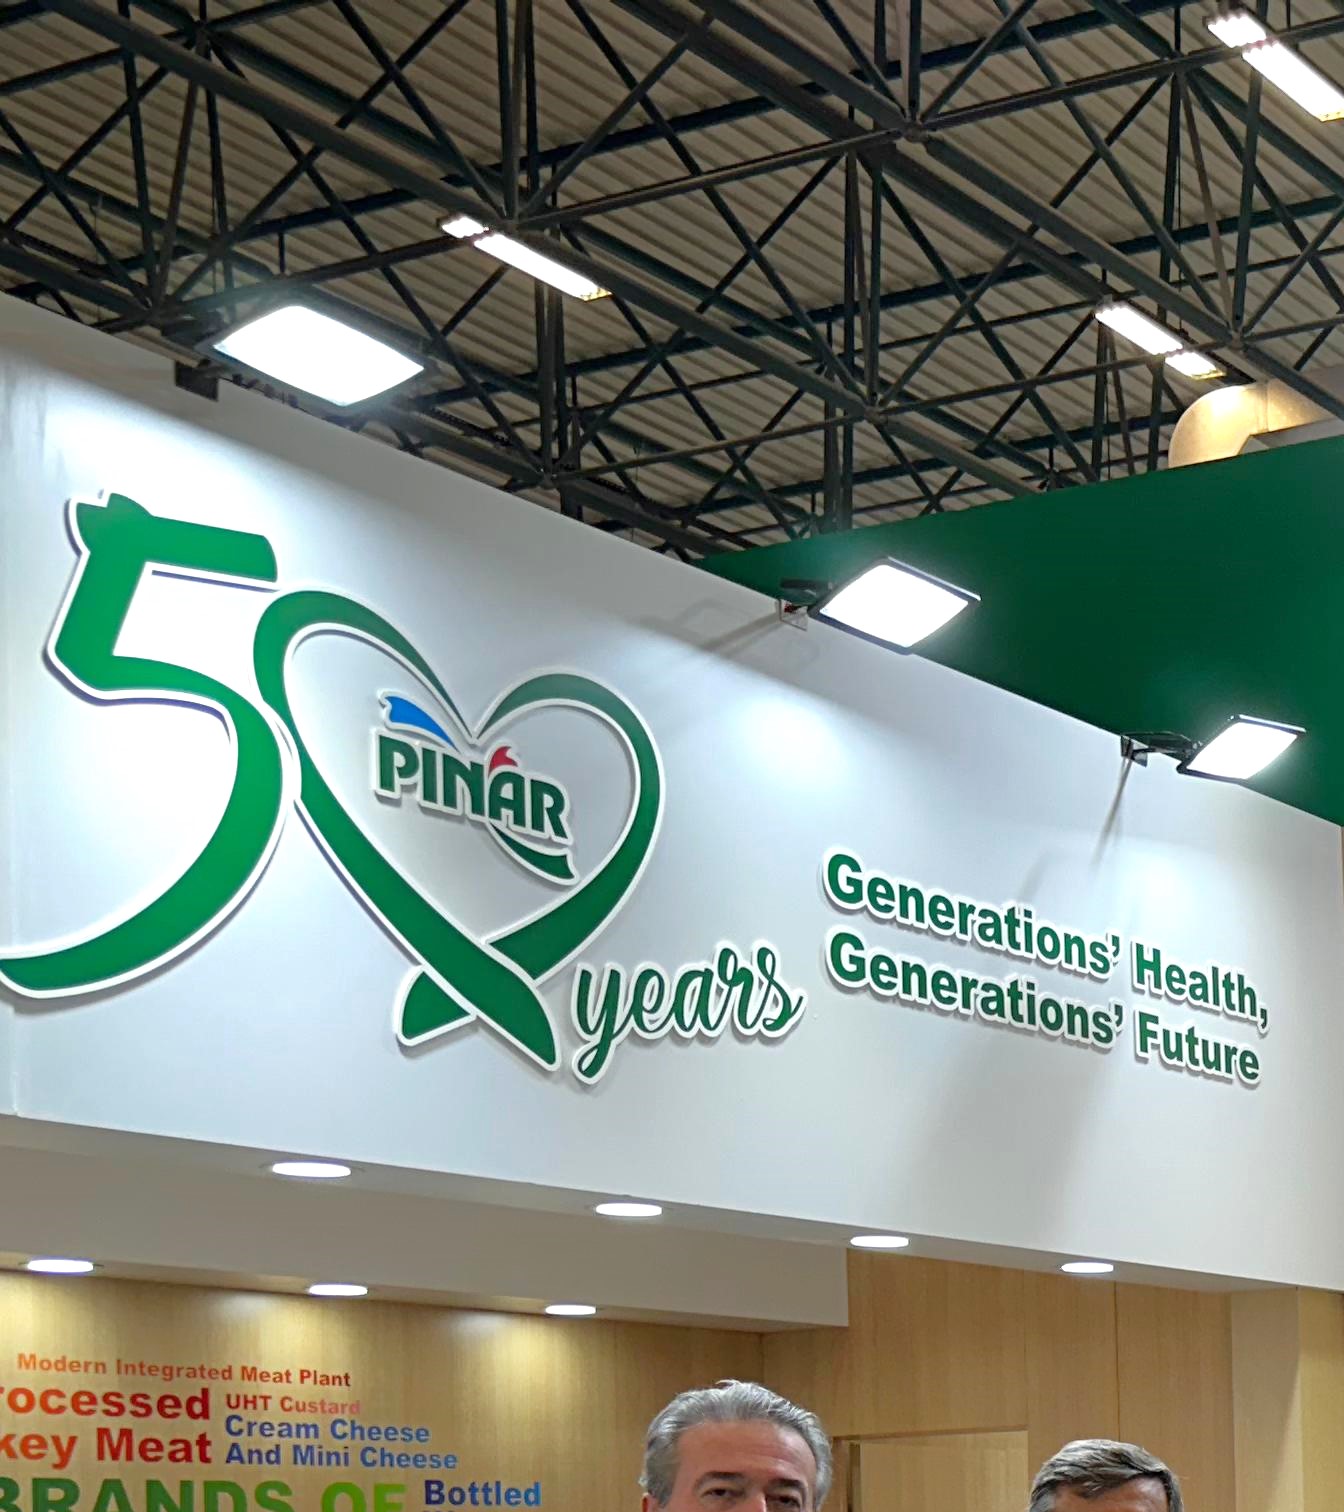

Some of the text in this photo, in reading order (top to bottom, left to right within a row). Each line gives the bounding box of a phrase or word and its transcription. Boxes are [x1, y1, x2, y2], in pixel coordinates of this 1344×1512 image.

[827, 854, 1269, 1030] Generations' Health,
[579, 945, 803, 1079] years
[830, 932, 1261, 1082] Generations' Future
[17, 1353, 352, 1387] Modern Integrated Meat Plant
[0, 1386, 210, 1420] ocessed
[226, 1393, 361, 1415] UHT Custard
[225, 1414, 429, 1442] Cream Cheese
[96, 1427, 212, 1464] Meat
[226, 1444, 457, 1469] And Mini Cheese
[425, 1480, 542, 1506] Bottled
